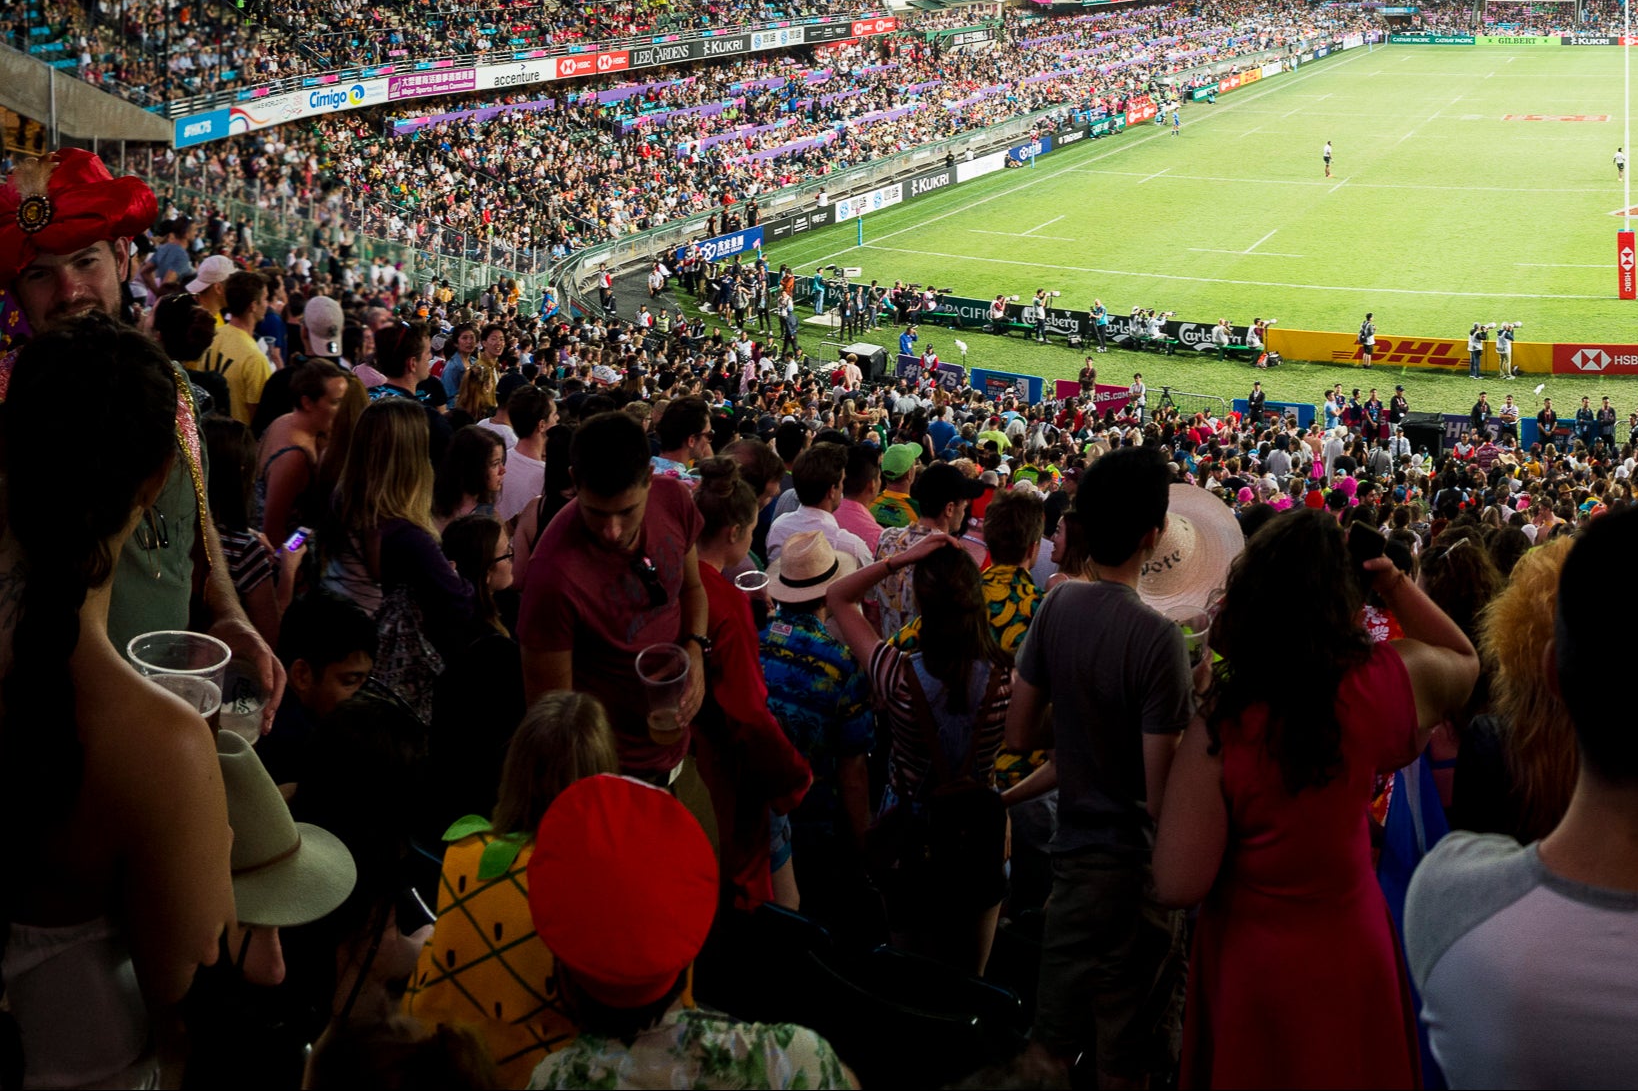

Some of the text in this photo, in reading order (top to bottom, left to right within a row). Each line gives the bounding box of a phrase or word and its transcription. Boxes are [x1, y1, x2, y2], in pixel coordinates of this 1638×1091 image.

[633, 44, 689, 65] LEE GARDENS
[711, 39, 743, 53] KUKRI
[577, 60, 591, 69] HSBC
[612, 56, 626, 65] HSBC
[494, 70, 539, 86] accenture
[309, 91, 347, 109] Cimigo
[919, 172, 949, 193] KUKRI
[1624, 272, 1632, 292] HSBC
[1352, 339, 1467, 367] DHL
